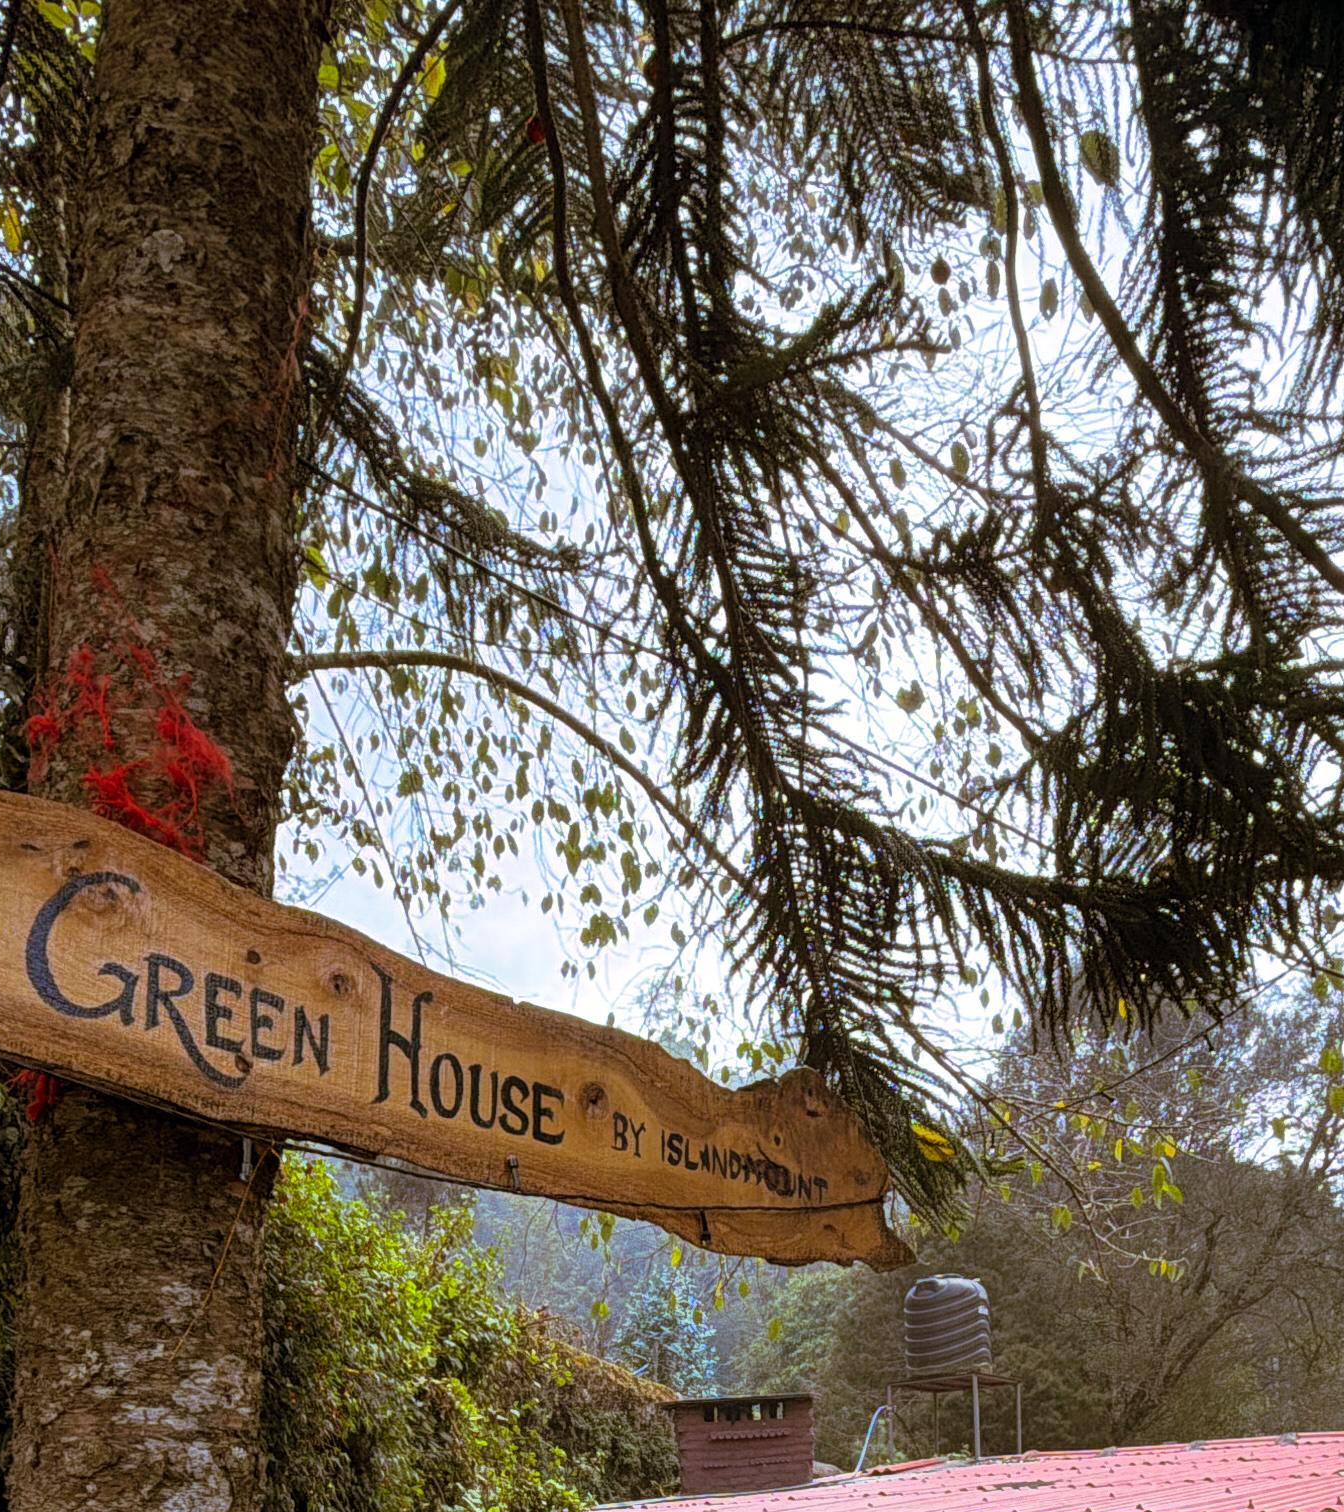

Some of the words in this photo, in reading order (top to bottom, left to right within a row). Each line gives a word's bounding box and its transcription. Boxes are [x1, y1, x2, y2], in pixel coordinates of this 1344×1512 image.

[24, 871, 330, 1088] GREEN
[371, 963, 565, 1146] HOUSE
[611, 1111, 646, 1158] BY
